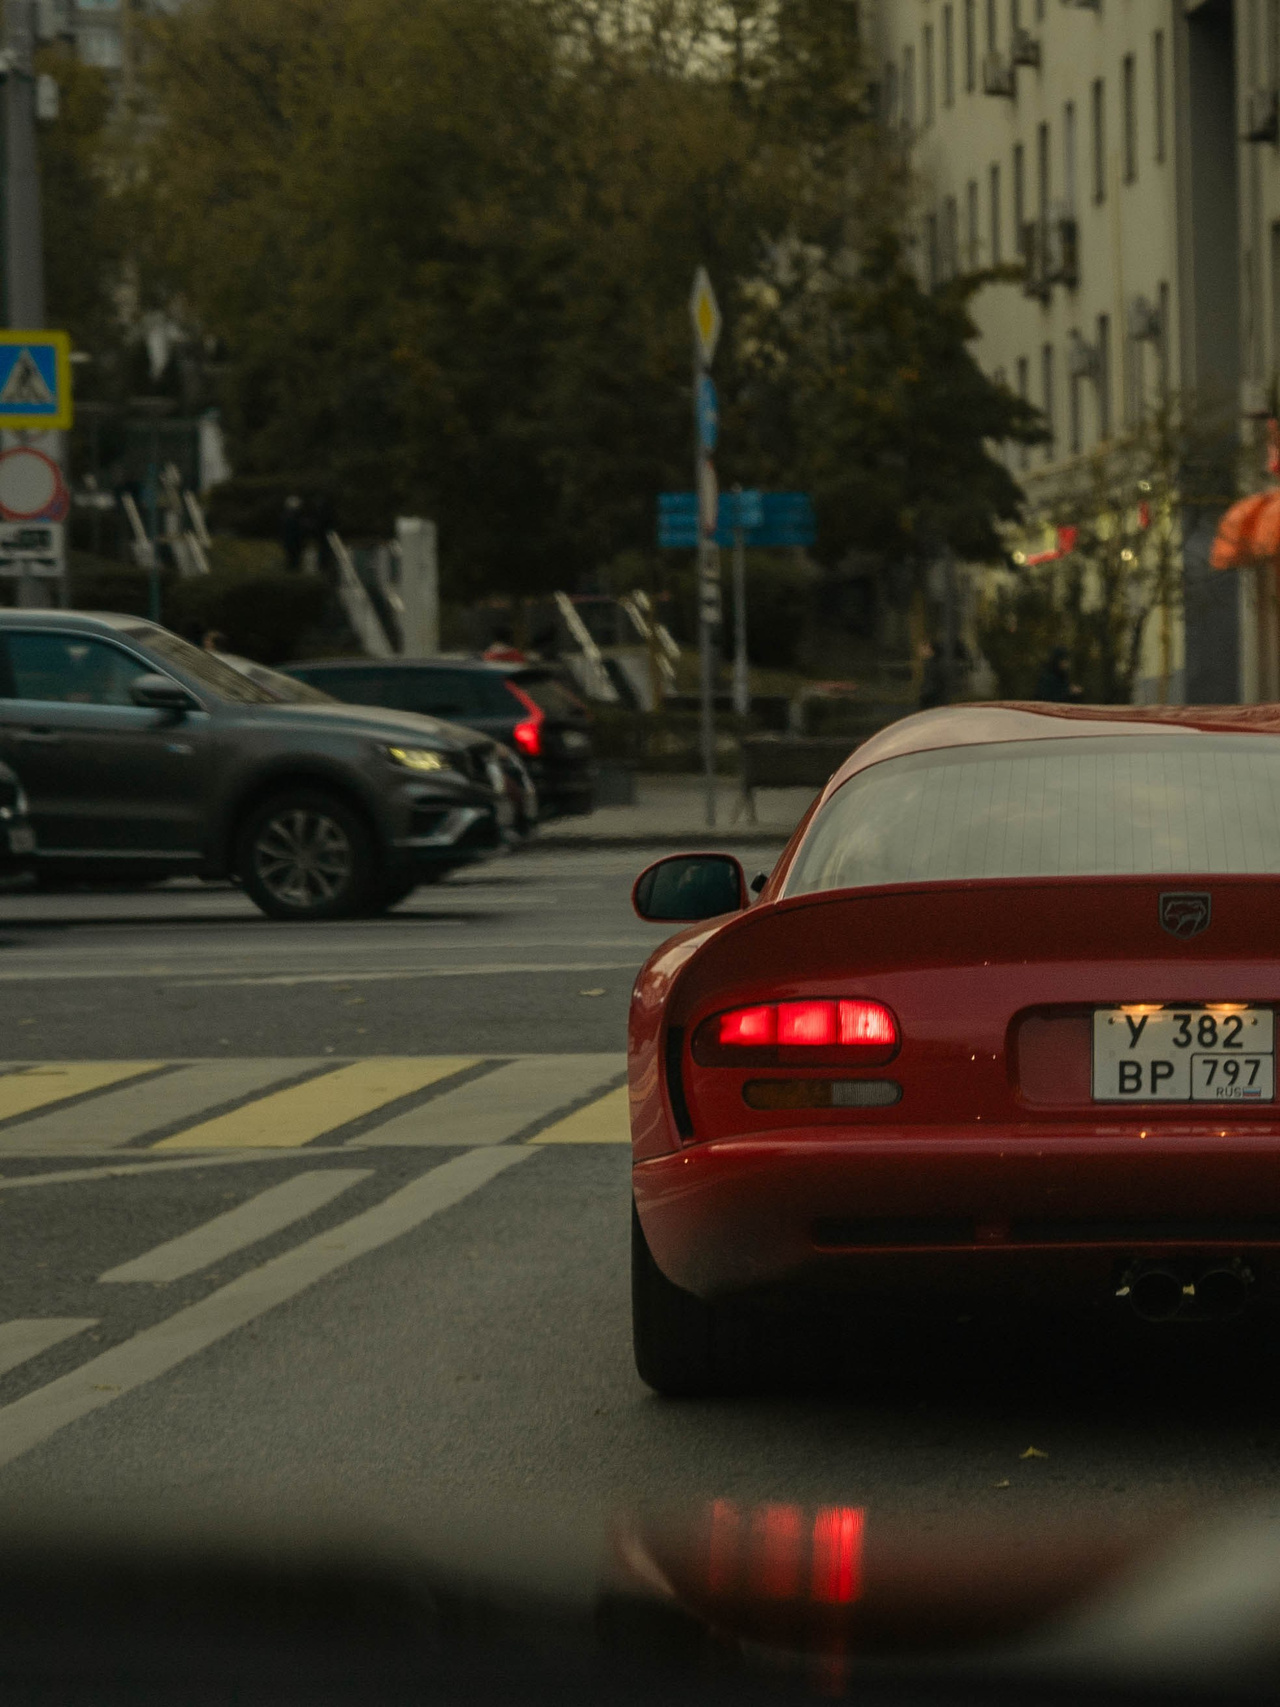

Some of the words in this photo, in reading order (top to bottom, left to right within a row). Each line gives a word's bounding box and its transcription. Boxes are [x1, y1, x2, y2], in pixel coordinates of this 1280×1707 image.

[1171, 1014, 1244, 1049] 382
[1202, 1059, 1261, 1086] 797
[1216, 1086, 1242, 1098] RUS
